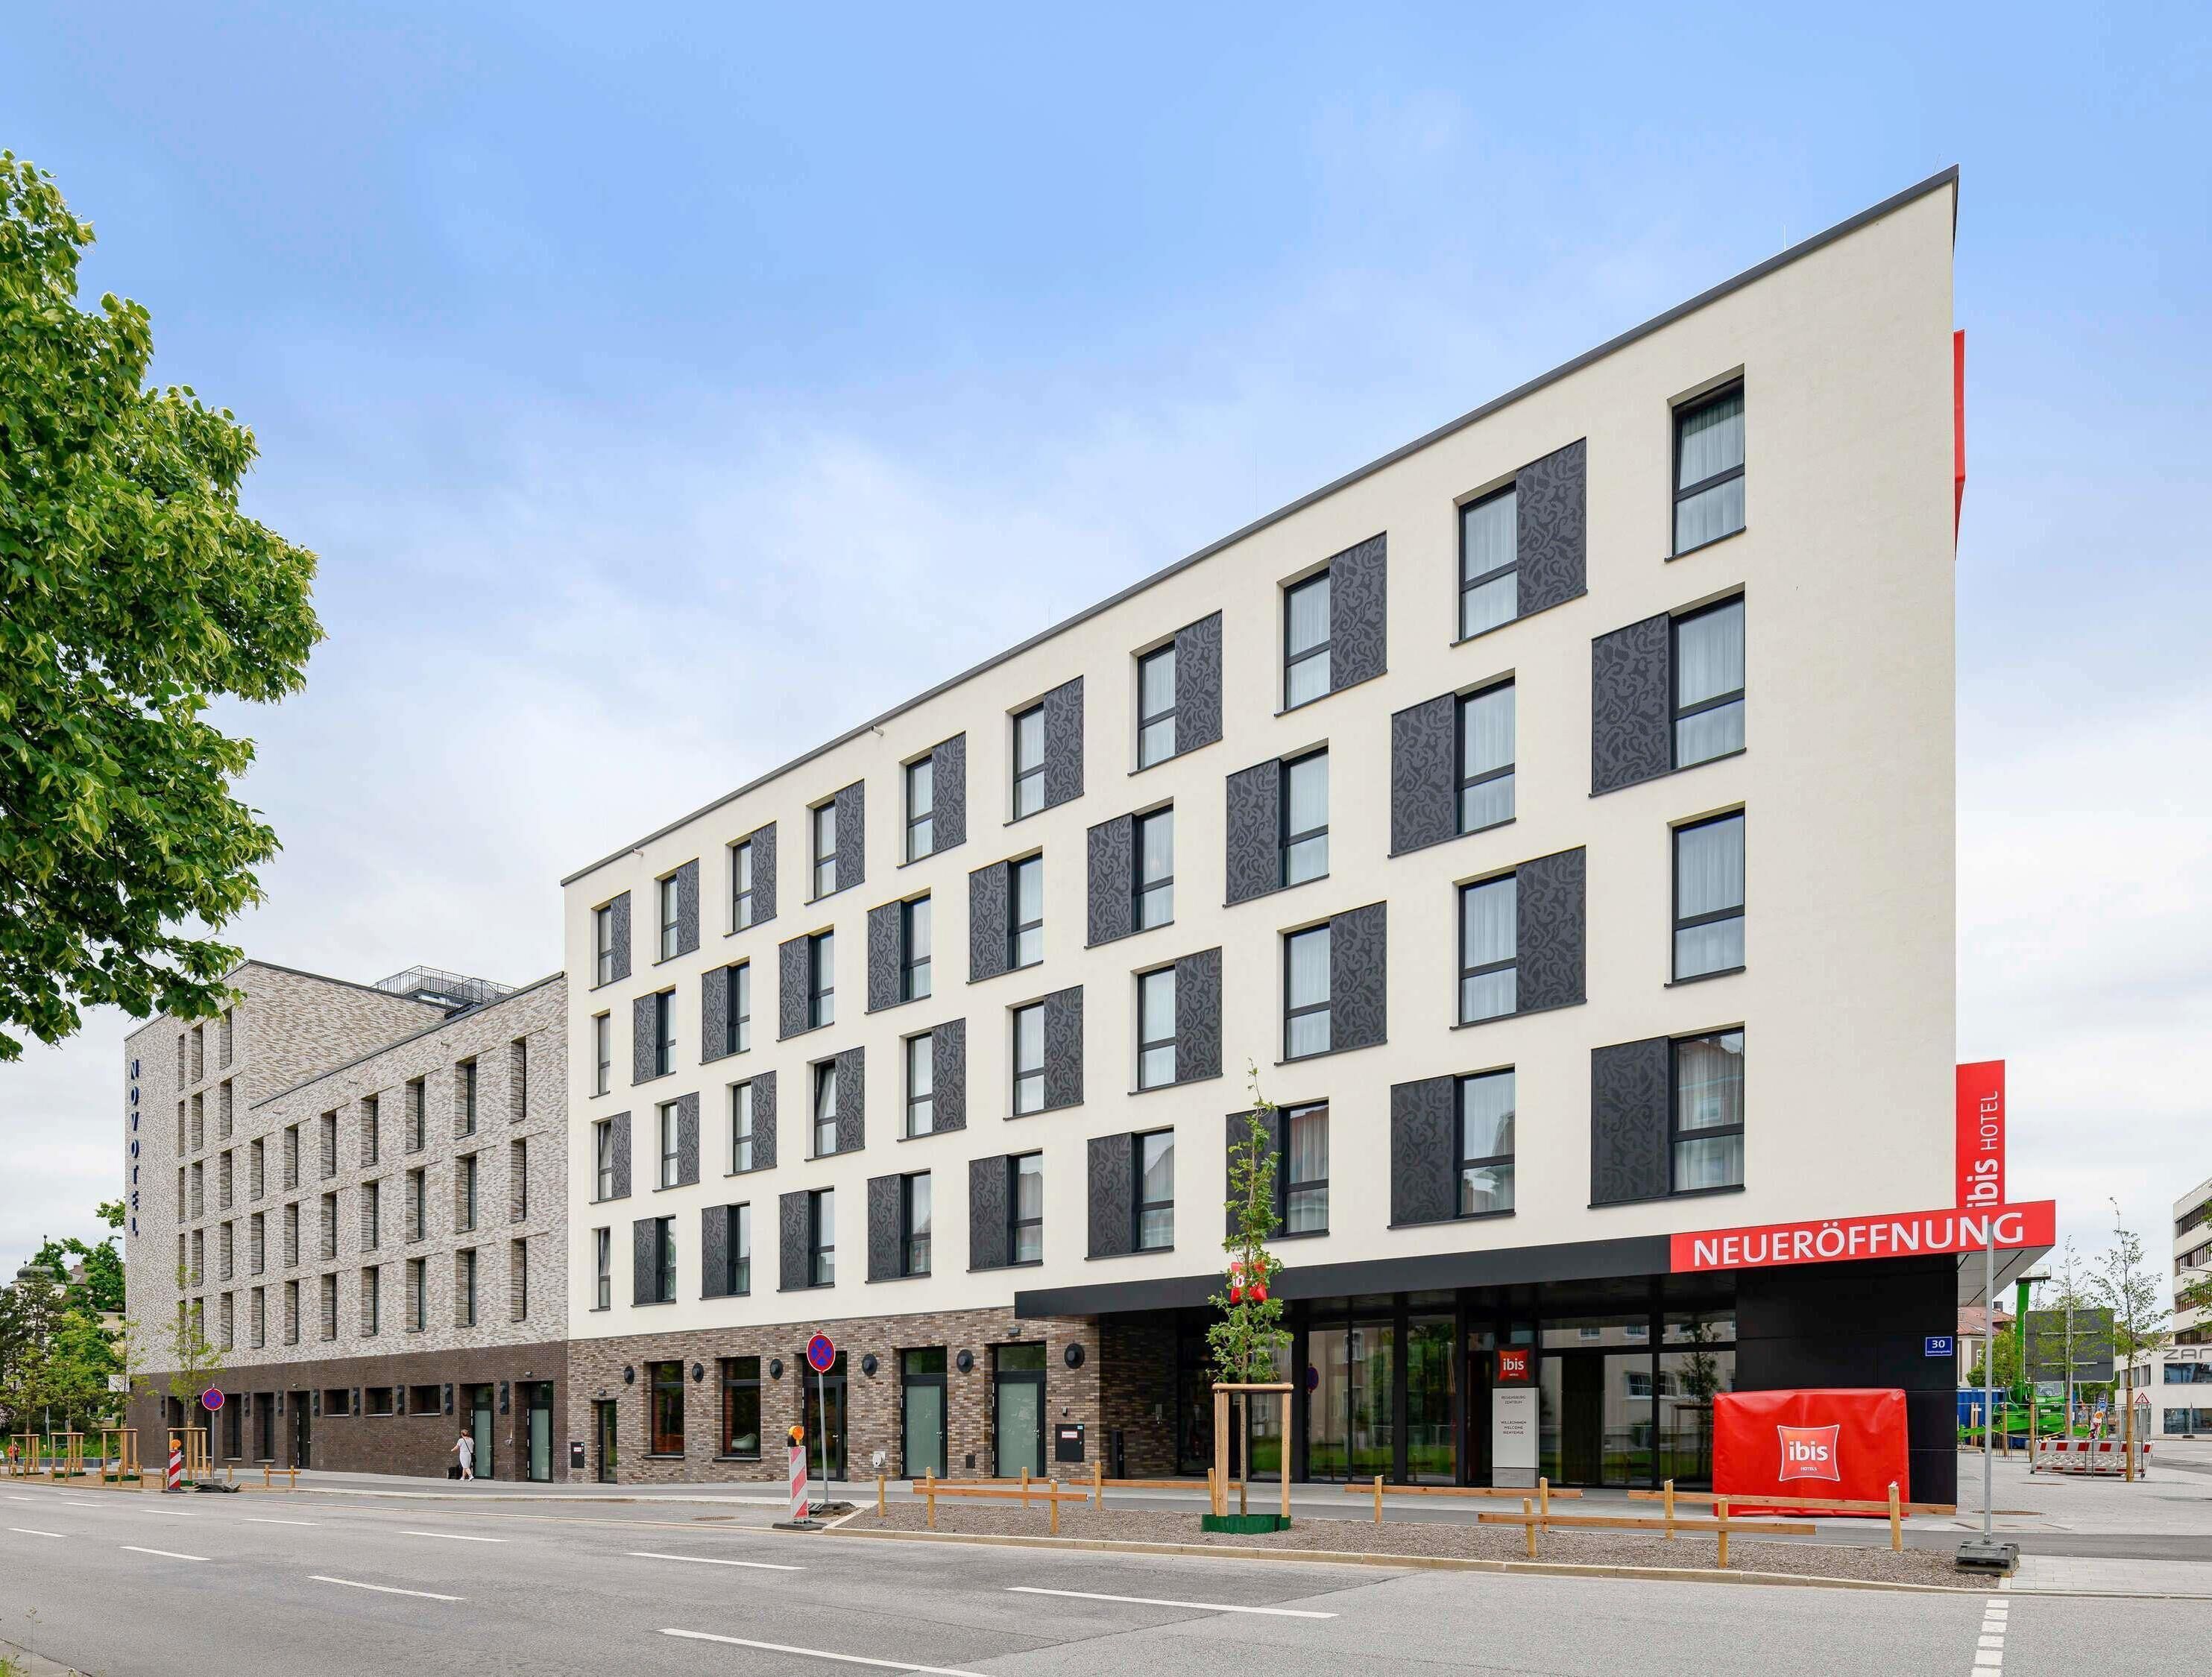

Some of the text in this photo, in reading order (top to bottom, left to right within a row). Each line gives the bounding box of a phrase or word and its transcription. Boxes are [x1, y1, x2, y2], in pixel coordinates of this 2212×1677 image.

[130, 1059, 139, 1237] NOVOTEL
[1967, 1090, 1998, 1208] ibis HOTEL
[1693, 1212, 2023, 1267] NEUERÖFFNUNG
[1932, 1339, 1945, 1348] 30
[1503, 1358, 1525, 1371] ibis
[1789, 1440, 1829, 1461] ibis
